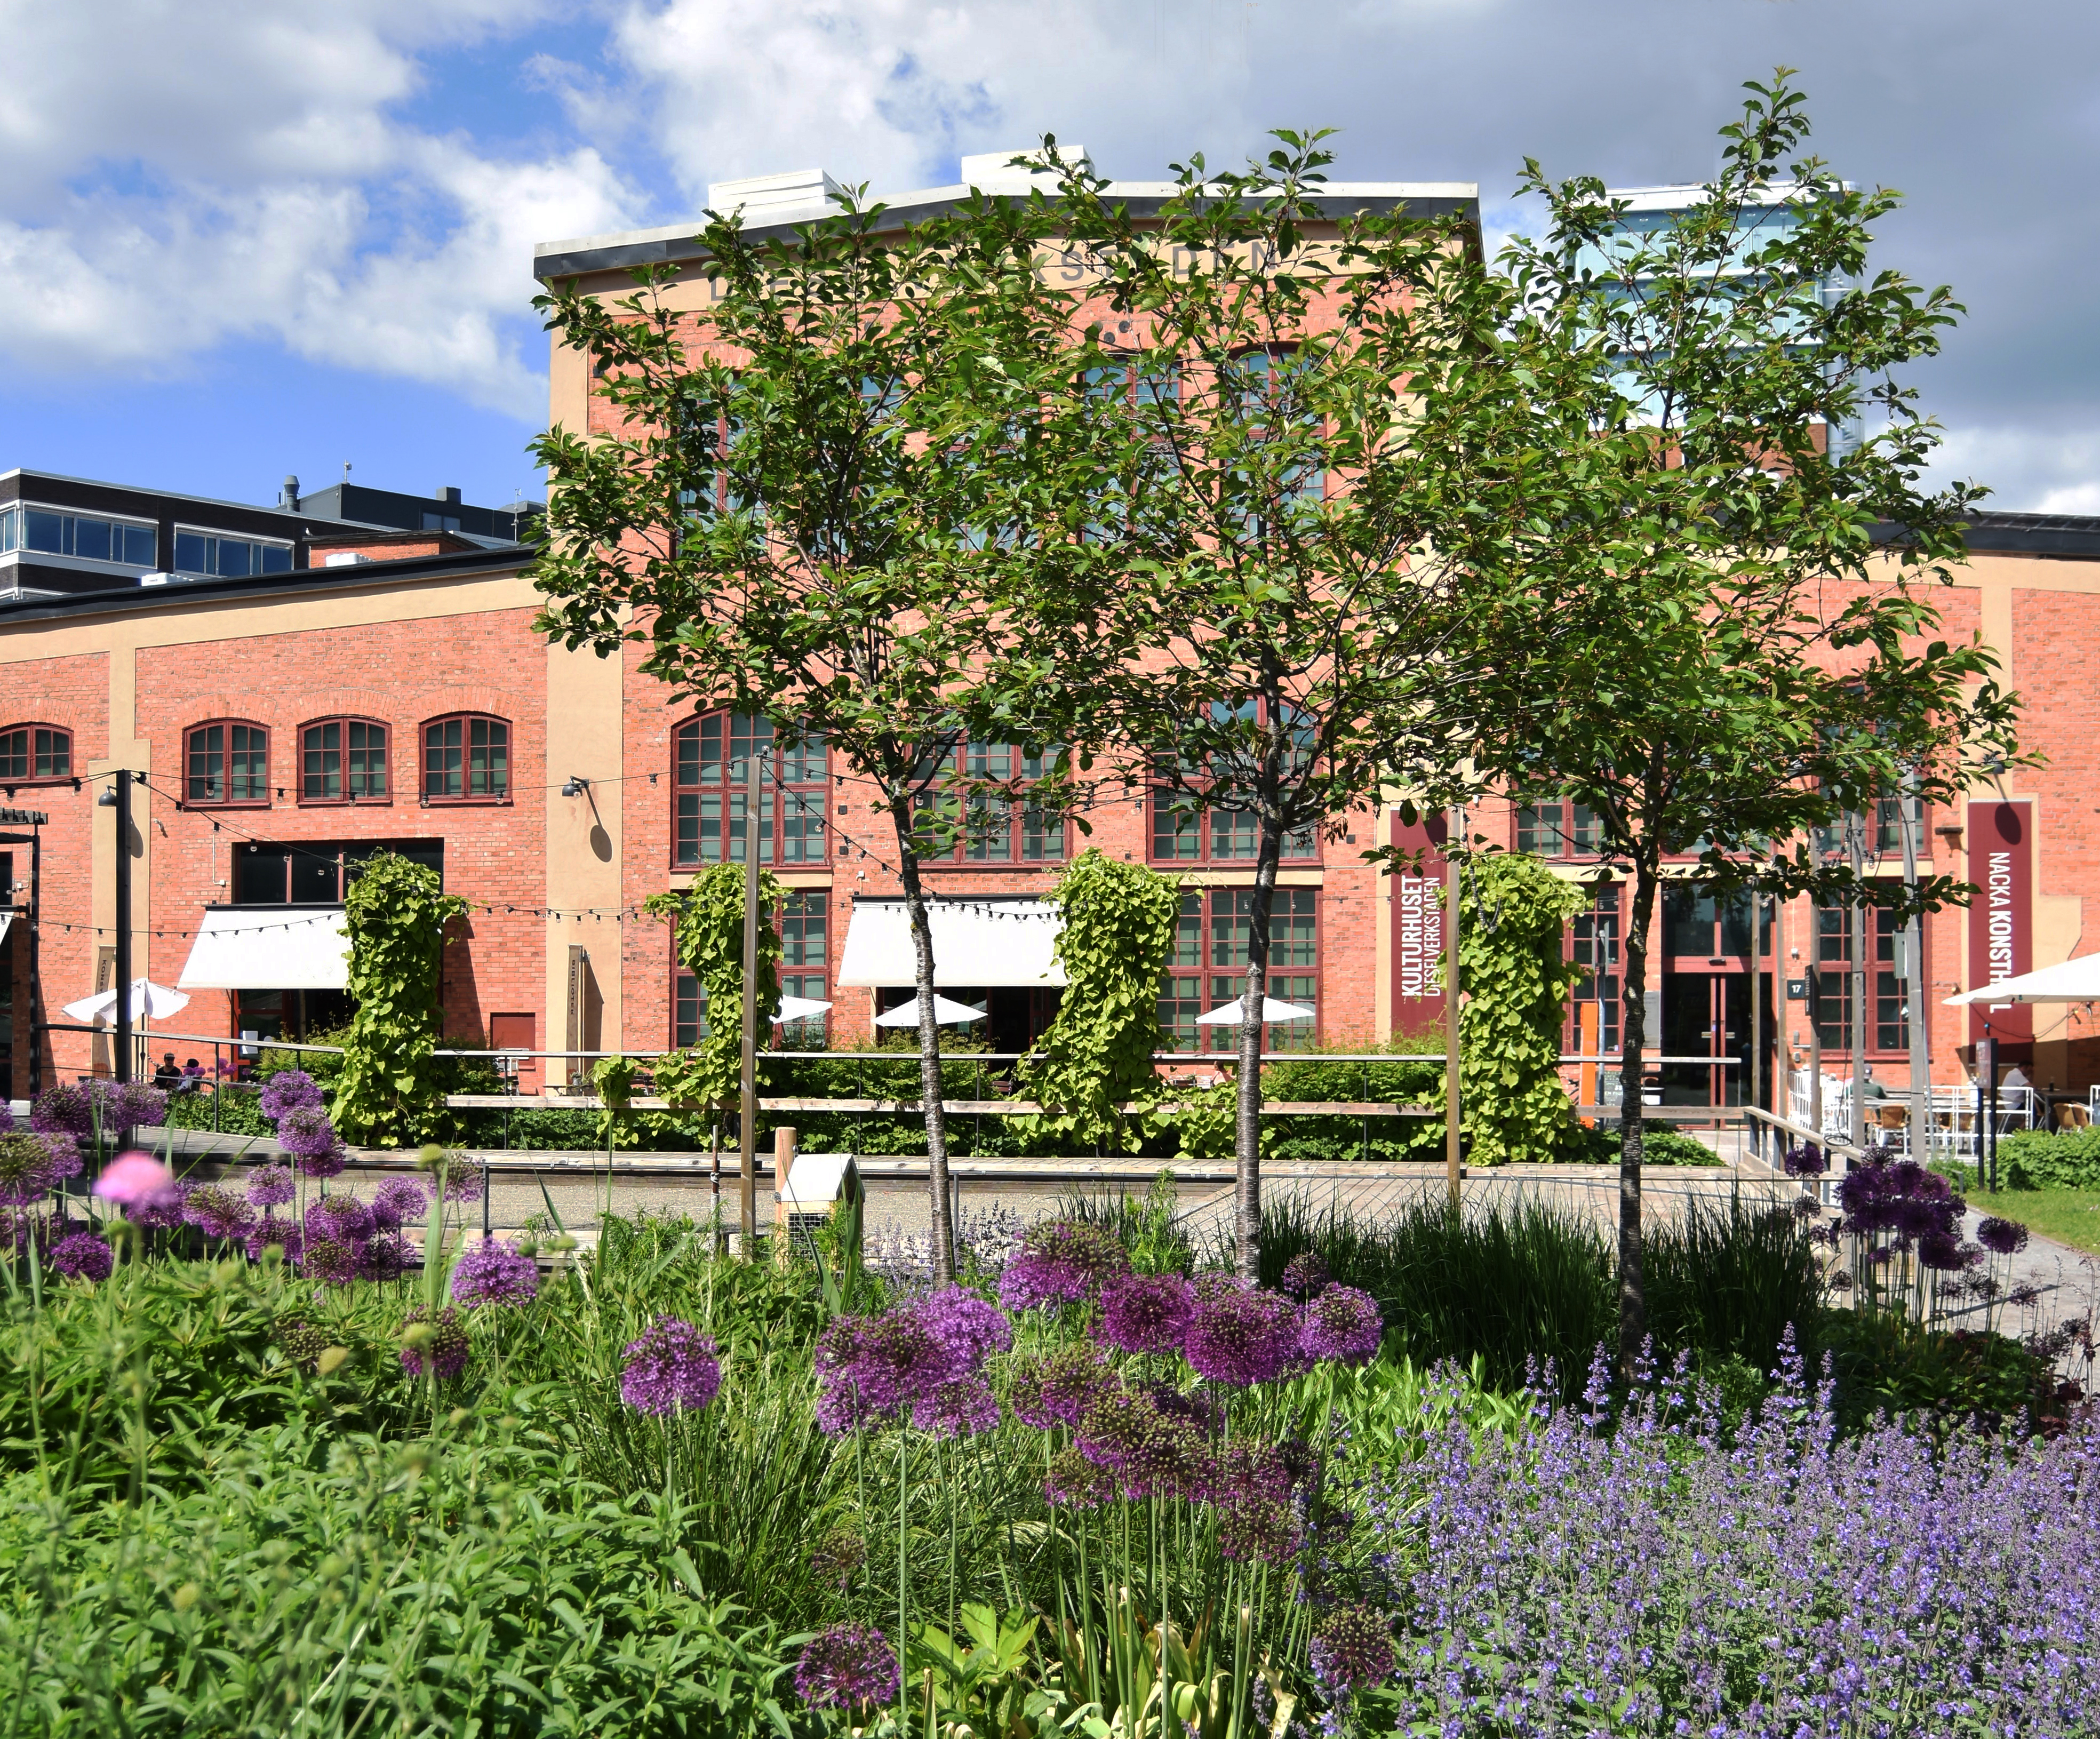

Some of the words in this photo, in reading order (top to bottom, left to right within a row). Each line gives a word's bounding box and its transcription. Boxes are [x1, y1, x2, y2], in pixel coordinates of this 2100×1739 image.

[1989, 852, 2010, 908] NACKA
[1401, 875, 1422, 996] KULTURHUSET
[1989, 911, 2011, 1014] KONSTHL
[1791, 984, 1802, 993] 17
